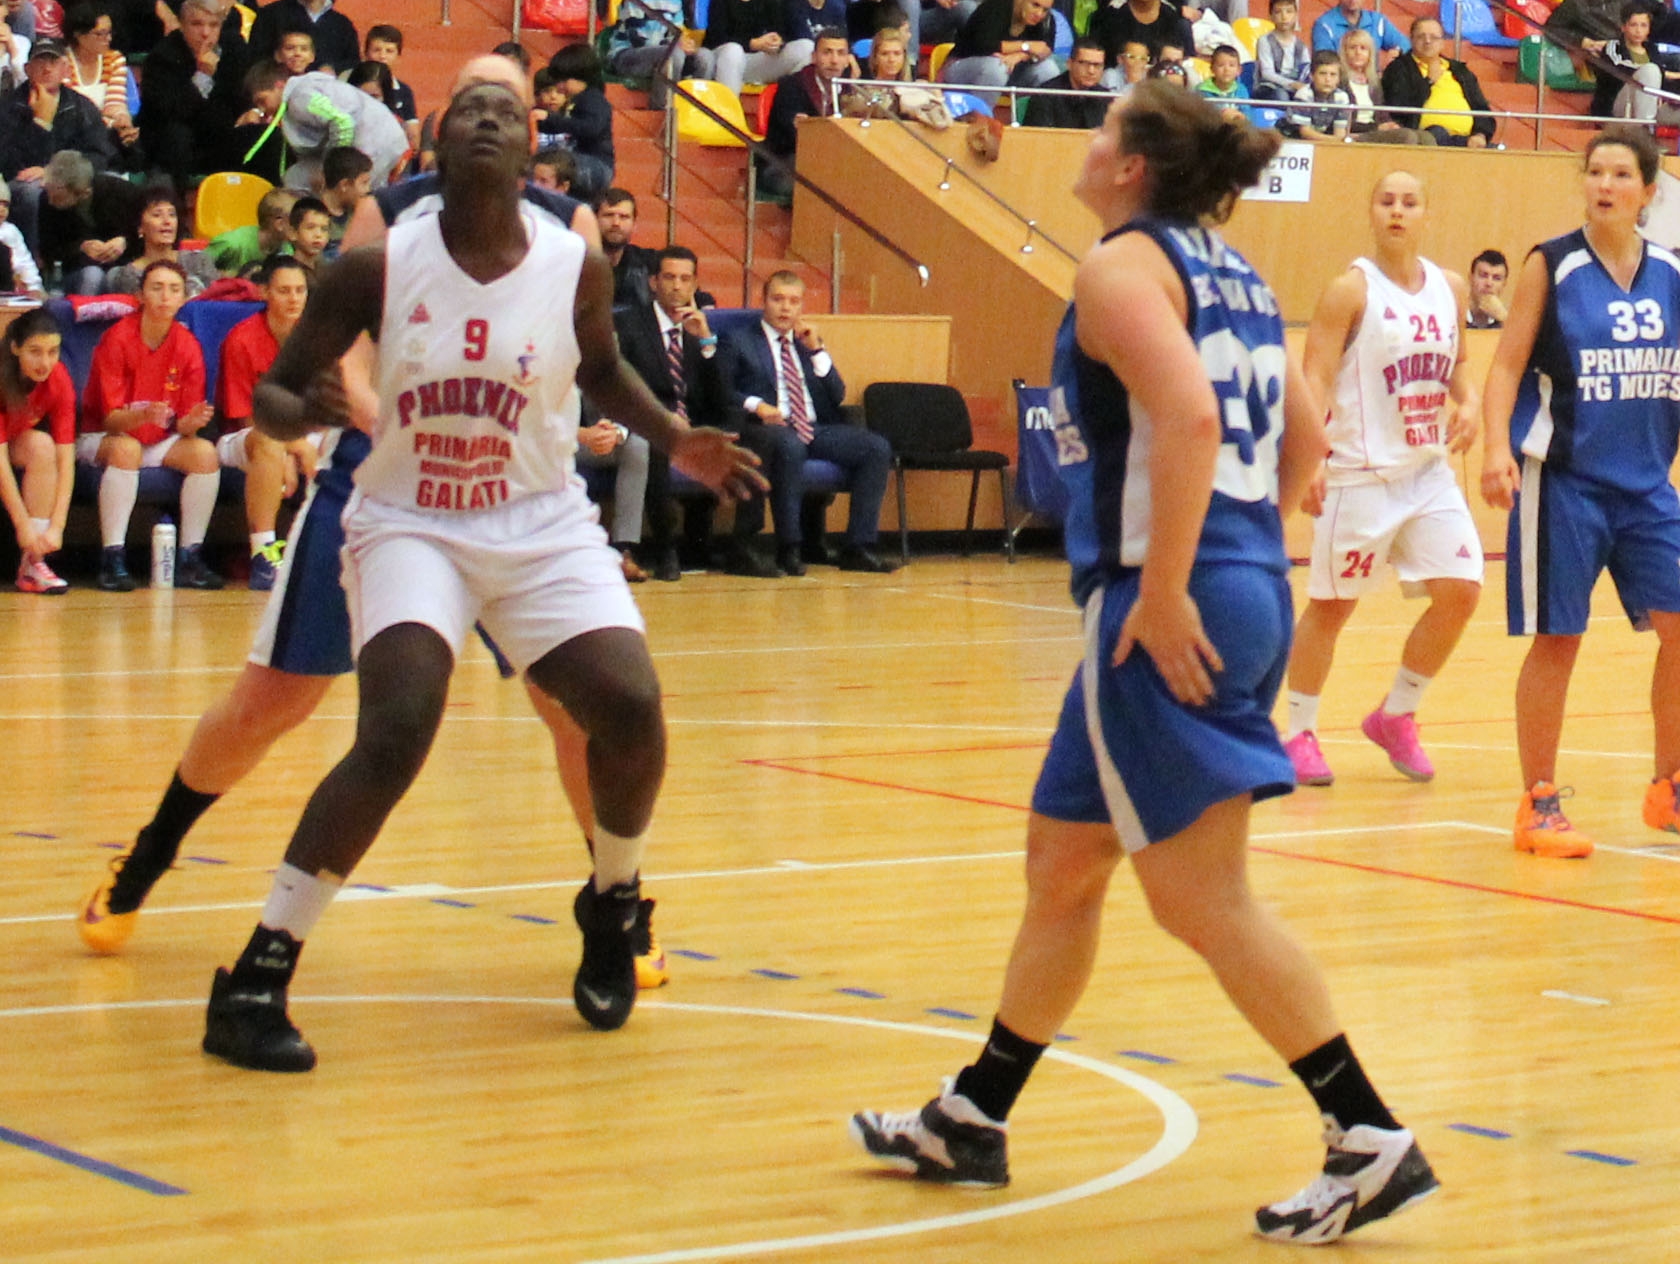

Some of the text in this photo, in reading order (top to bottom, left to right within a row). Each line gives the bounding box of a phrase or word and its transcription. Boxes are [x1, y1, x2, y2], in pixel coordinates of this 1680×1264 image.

[1269, 176, 1283, 194] B
[1409, 314, 1441, 342] 24
[1607, 298, 1665, 343] 33
[463, 319, 489, 362] 9
[1577, 376, 1614, 402] TG
[416, 479, 509, 510] GALATI
[1340, 550, 1375, 578] 24
